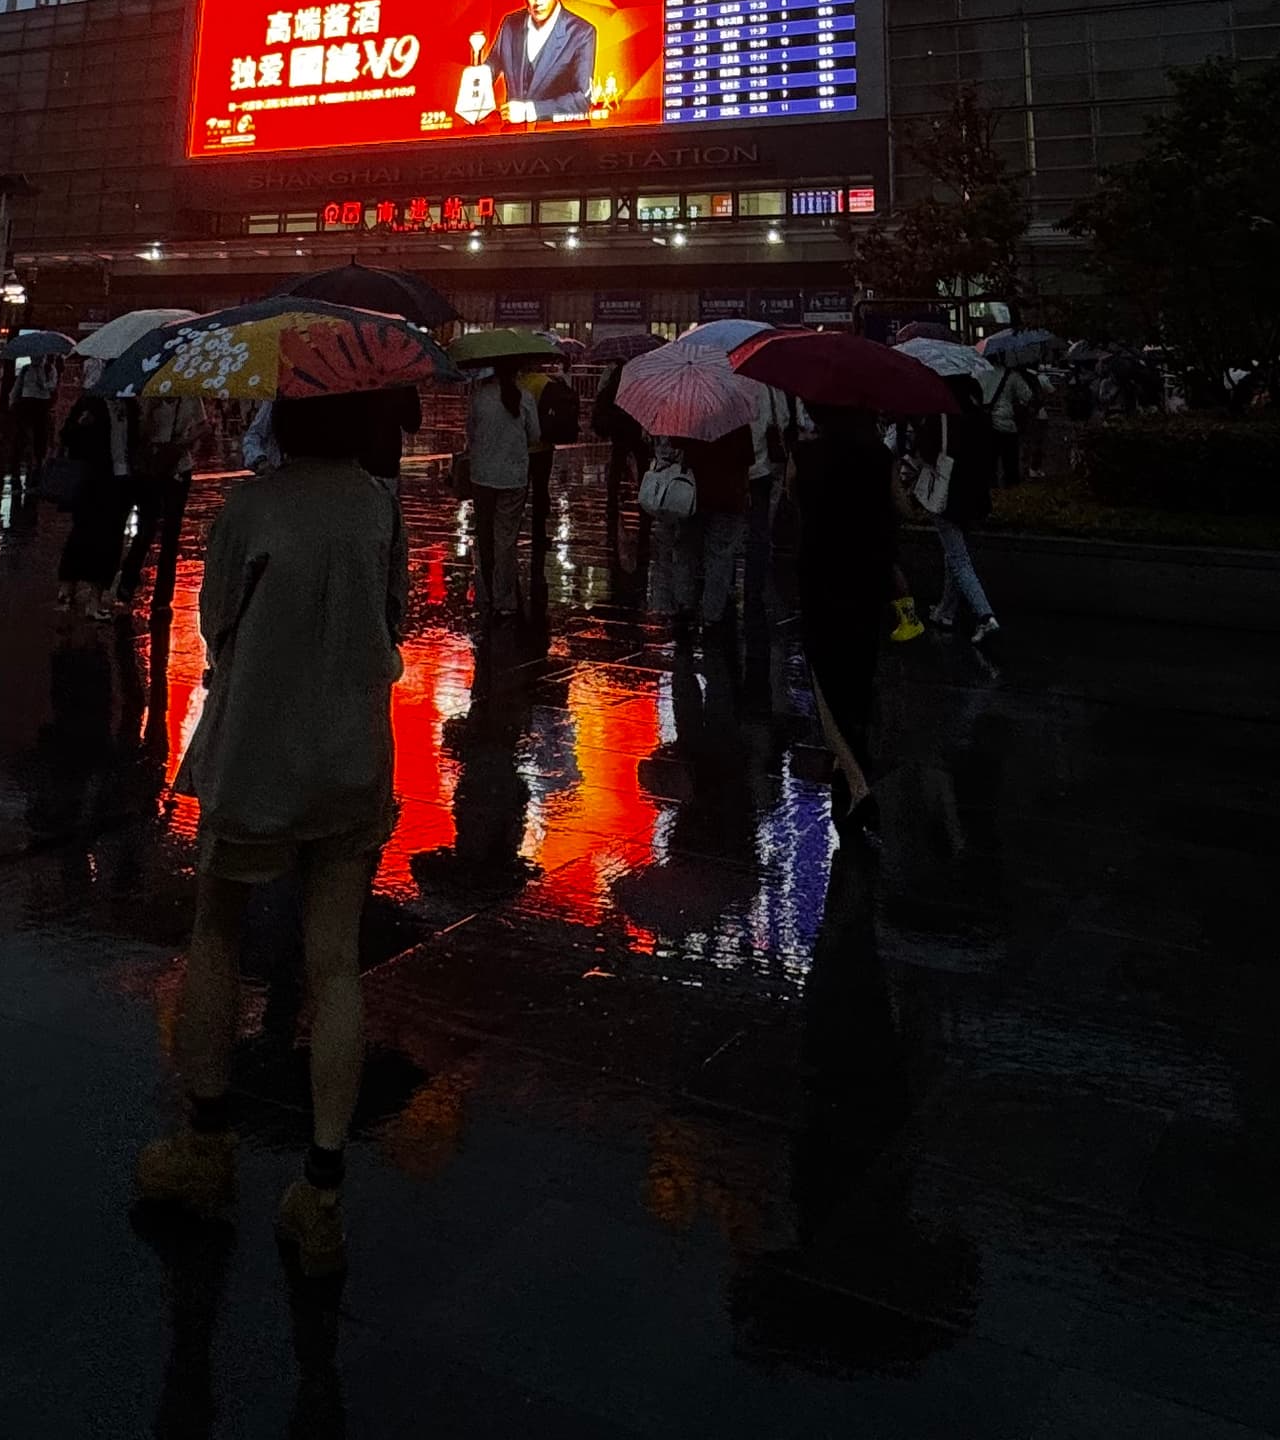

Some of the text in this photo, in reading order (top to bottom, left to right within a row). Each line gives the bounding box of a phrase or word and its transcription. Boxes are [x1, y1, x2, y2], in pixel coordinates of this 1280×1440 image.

[265, 0, 381, 45] 高端酱酒
[749, 52, 767, 61] 19:44
[421, 111, 446, 125] 2299
[247, 143, 759, 191] SHANGHAI RAILWAY STATION
[377, 197, 494, 222] 南进站口
